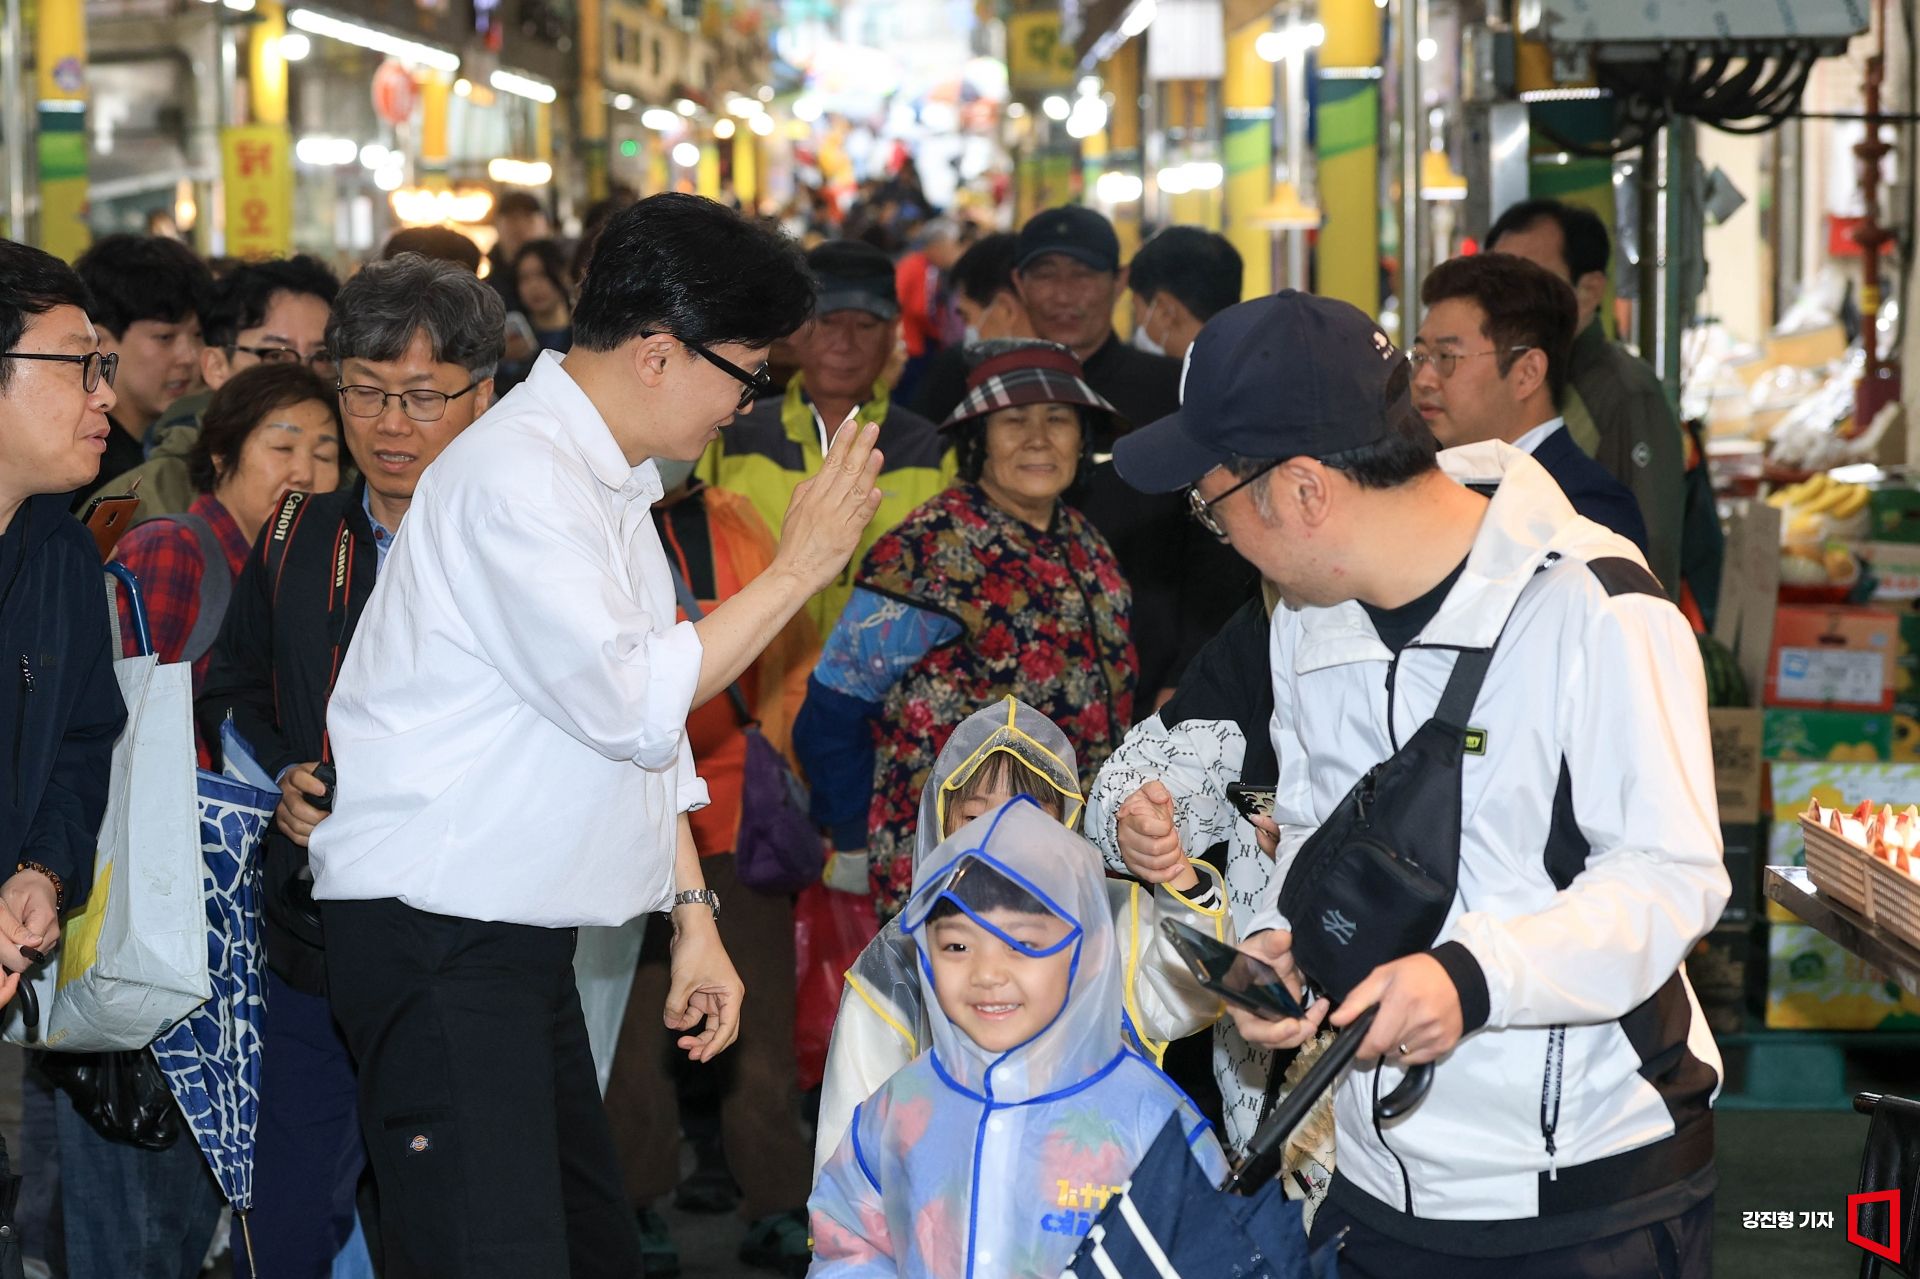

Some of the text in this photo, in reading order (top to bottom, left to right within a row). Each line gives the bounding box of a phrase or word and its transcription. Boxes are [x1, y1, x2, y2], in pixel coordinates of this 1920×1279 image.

[273, 492, 303, 541] Canon
[335, 528, 350, 589] Canon
[1240, 843, 1262, 859] NY
[1231, 889, 1254, 907] NY
[1321, 909, 1357, 945] NY
[1238, 1092, 1259, 1112] NY
[1056, 1179, 1122, 1210] litt
